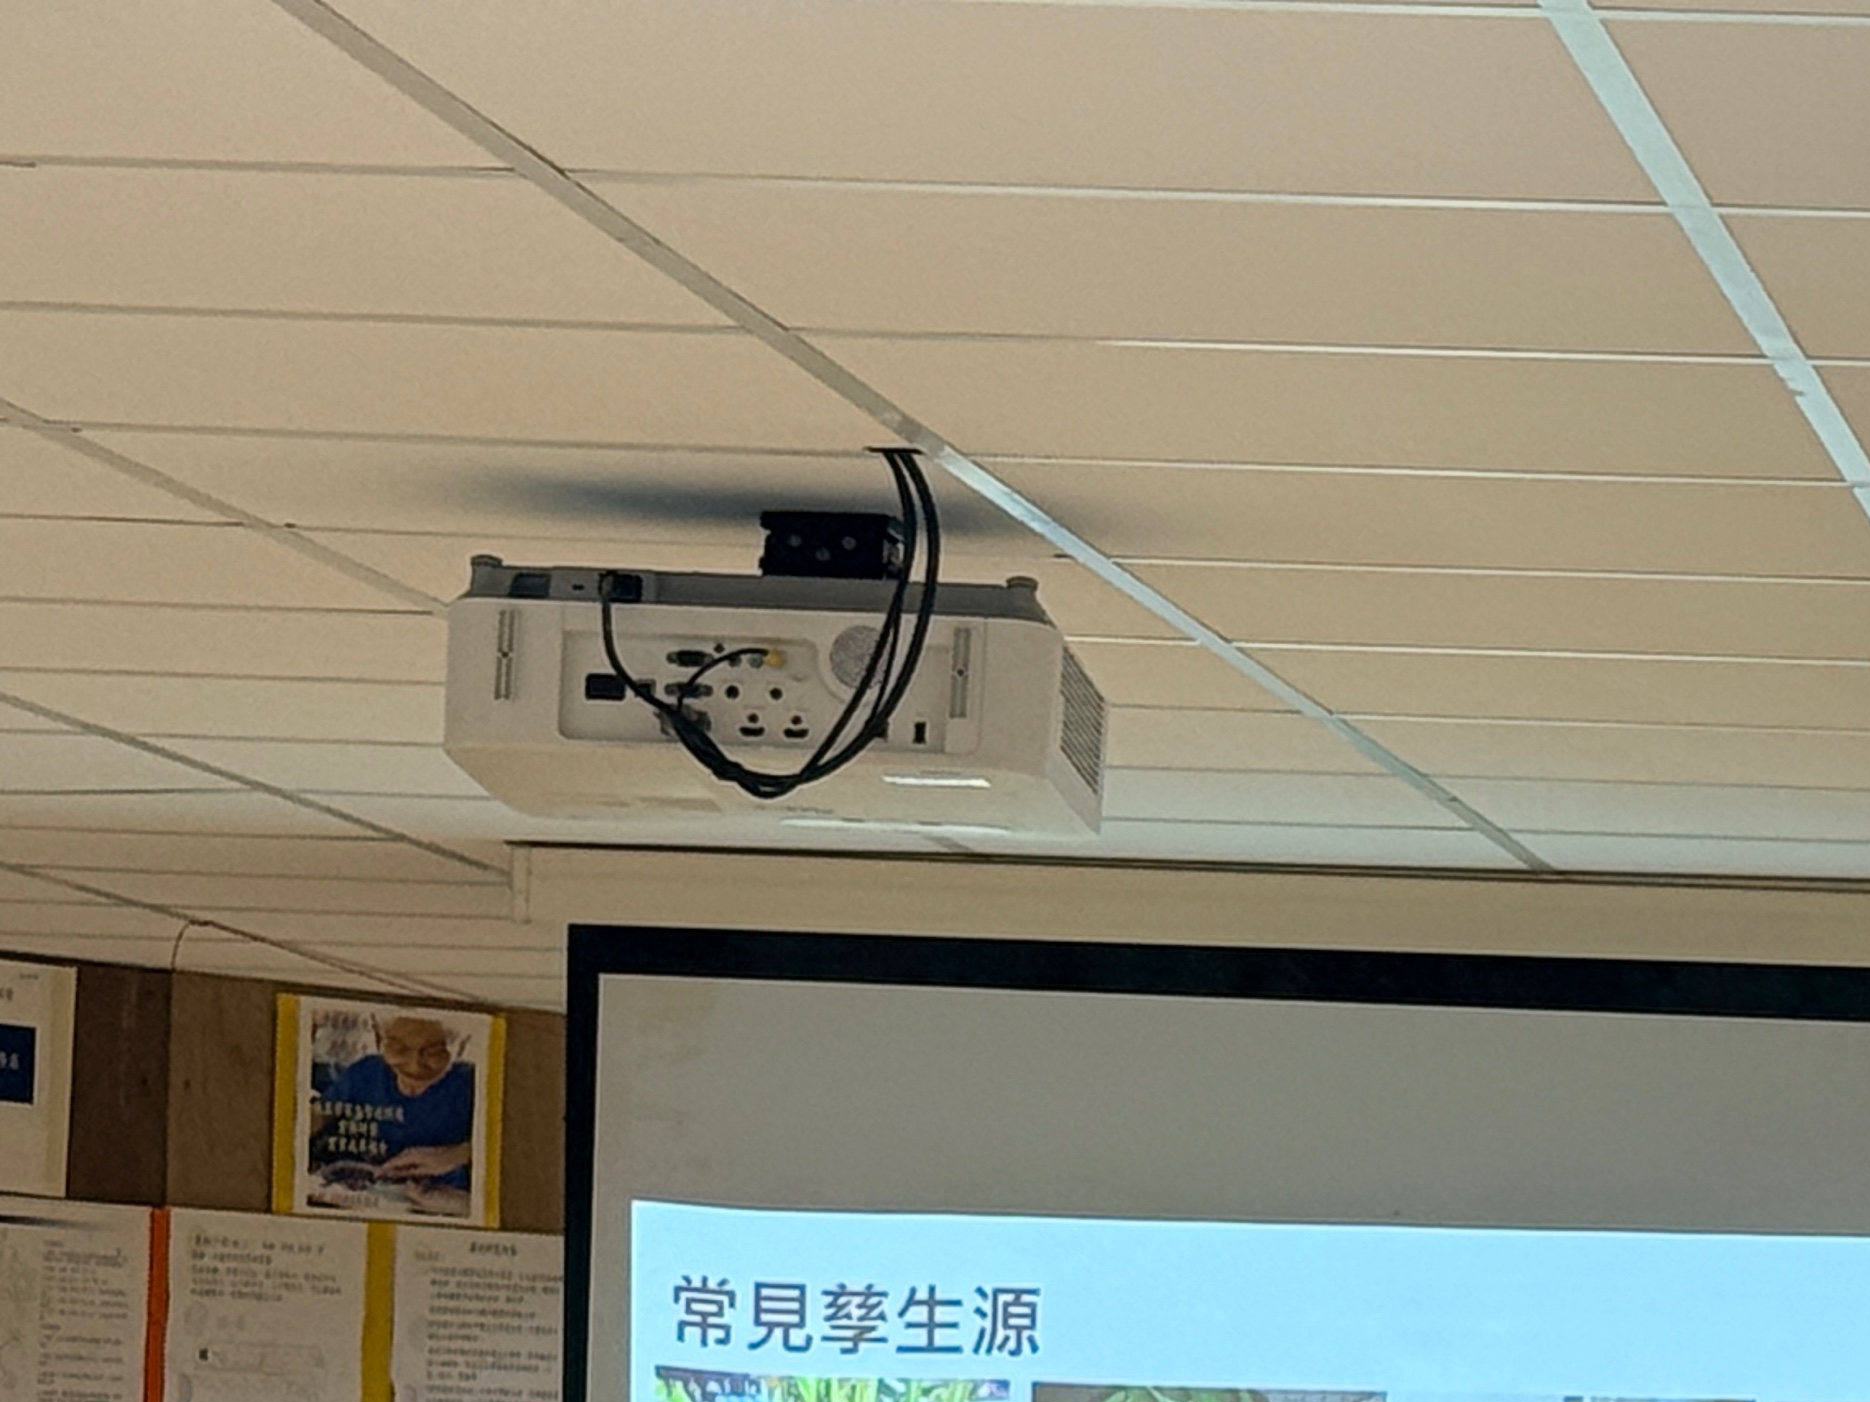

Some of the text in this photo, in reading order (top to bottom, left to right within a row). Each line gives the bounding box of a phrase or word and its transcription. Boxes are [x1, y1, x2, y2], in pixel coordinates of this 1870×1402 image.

[673, 1274, 1041, 1356] 常見孳生源
